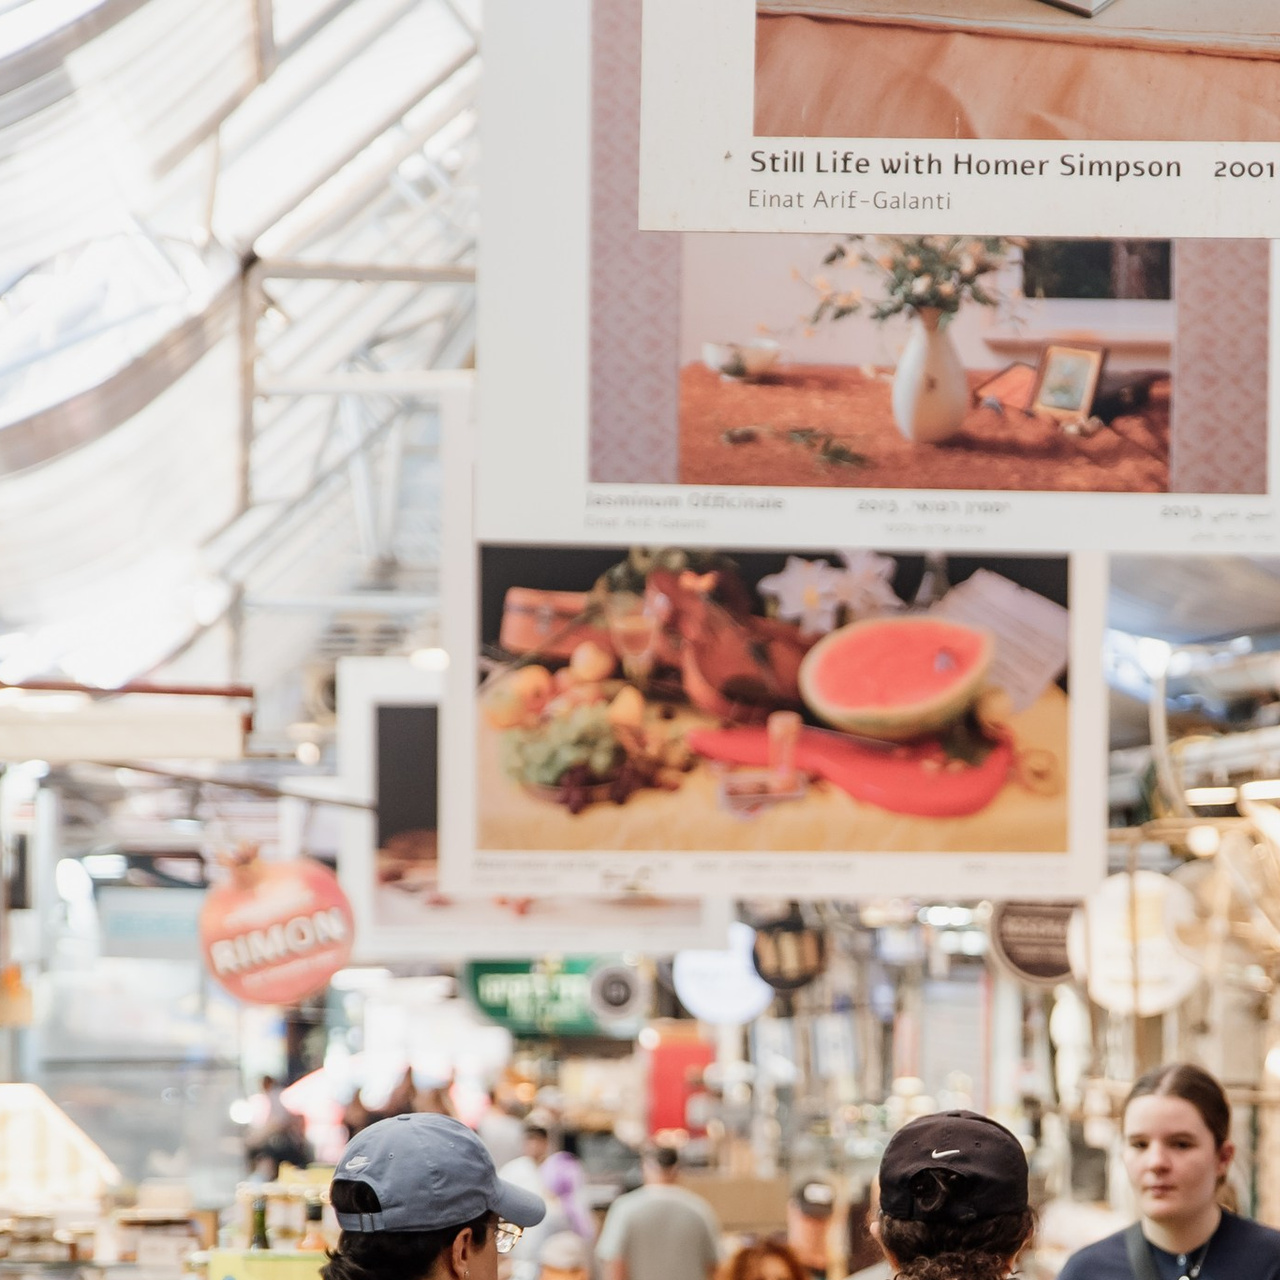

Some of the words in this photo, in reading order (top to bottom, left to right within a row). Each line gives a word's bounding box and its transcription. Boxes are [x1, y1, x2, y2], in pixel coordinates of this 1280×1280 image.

[750, 150, 804, 173] Still
[816, 151, 870, 174] Life
[880, 151, 942, 175] with
[953, 153, 1050, 175] Homer
[1060, 153, 1182, 182] Simpson
[1214, 161, 1275, 178] 2001
[749, 189, 804, 208] Einat
[813, 190, 952, 210] Arif-Galanti
[211, 907, 345, 975] RIMON
